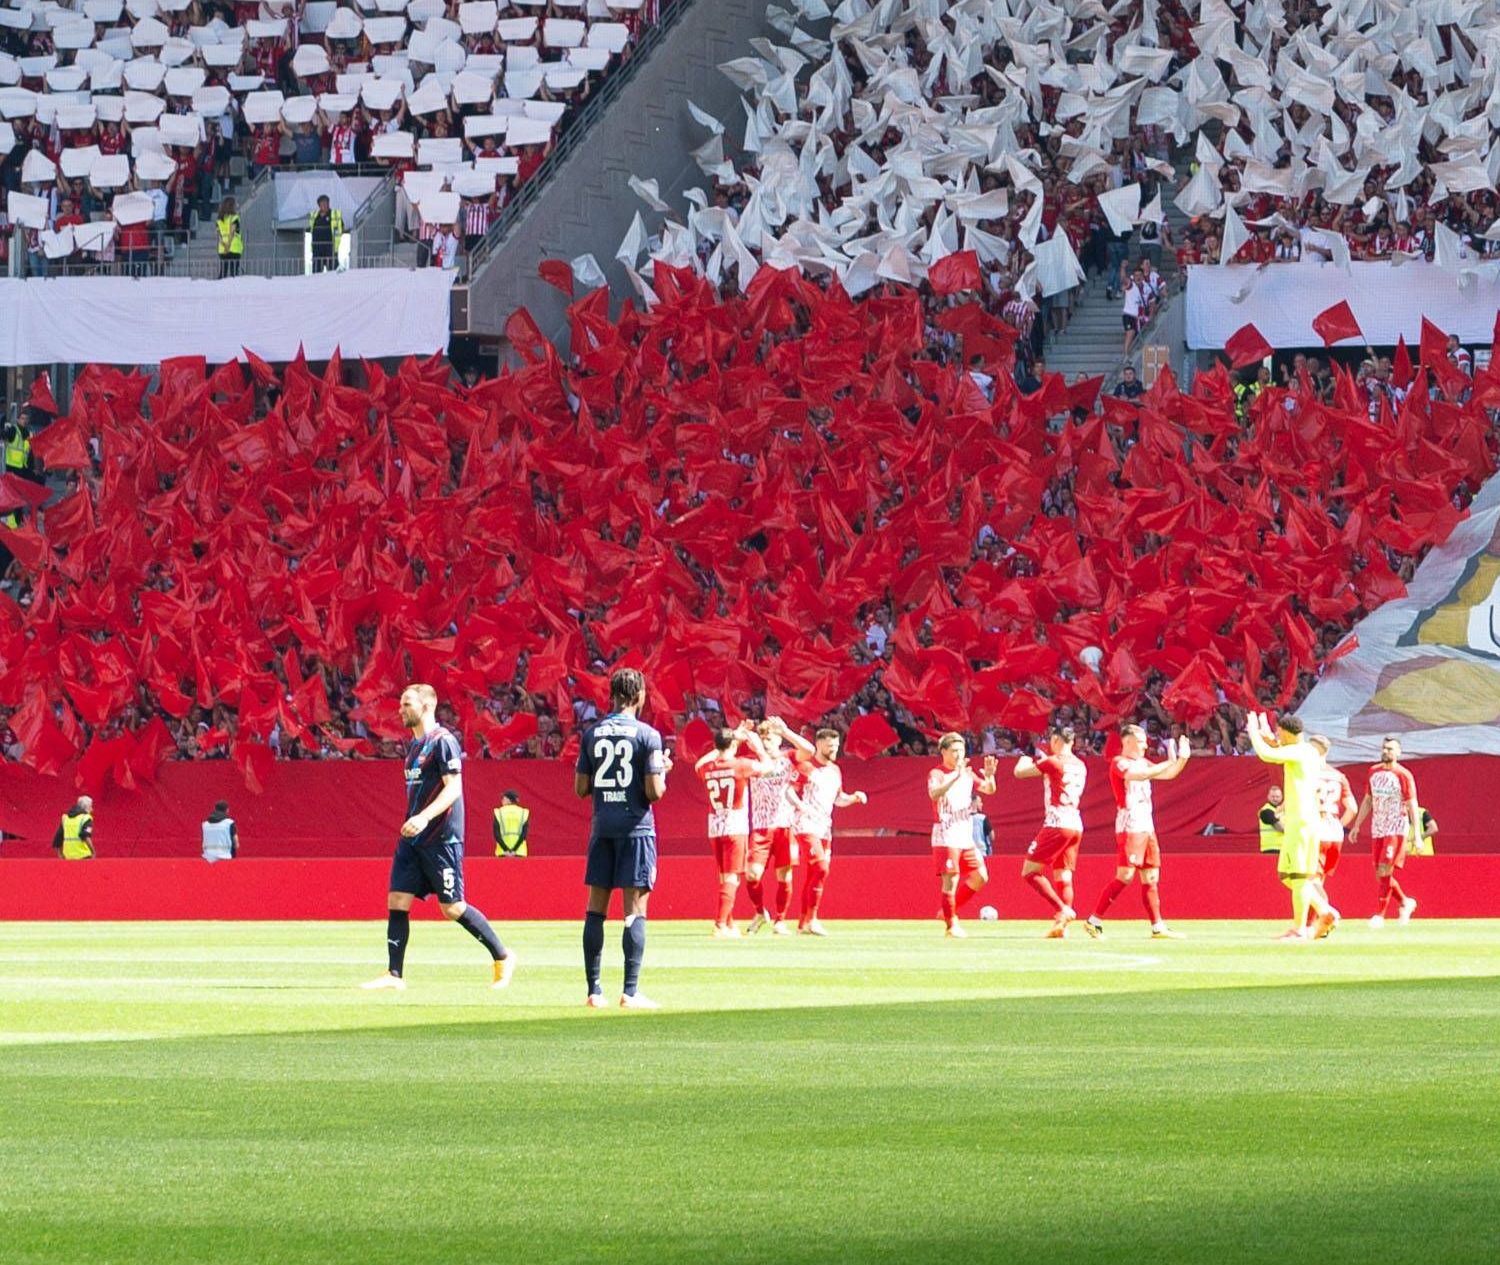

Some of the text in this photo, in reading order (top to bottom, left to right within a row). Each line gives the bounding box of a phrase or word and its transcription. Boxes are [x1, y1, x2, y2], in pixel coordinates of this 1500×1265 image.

[594, 738, 633, 788] 23
[706, 778, 735, 811] 27
[443, 868, 455, 889] 5
